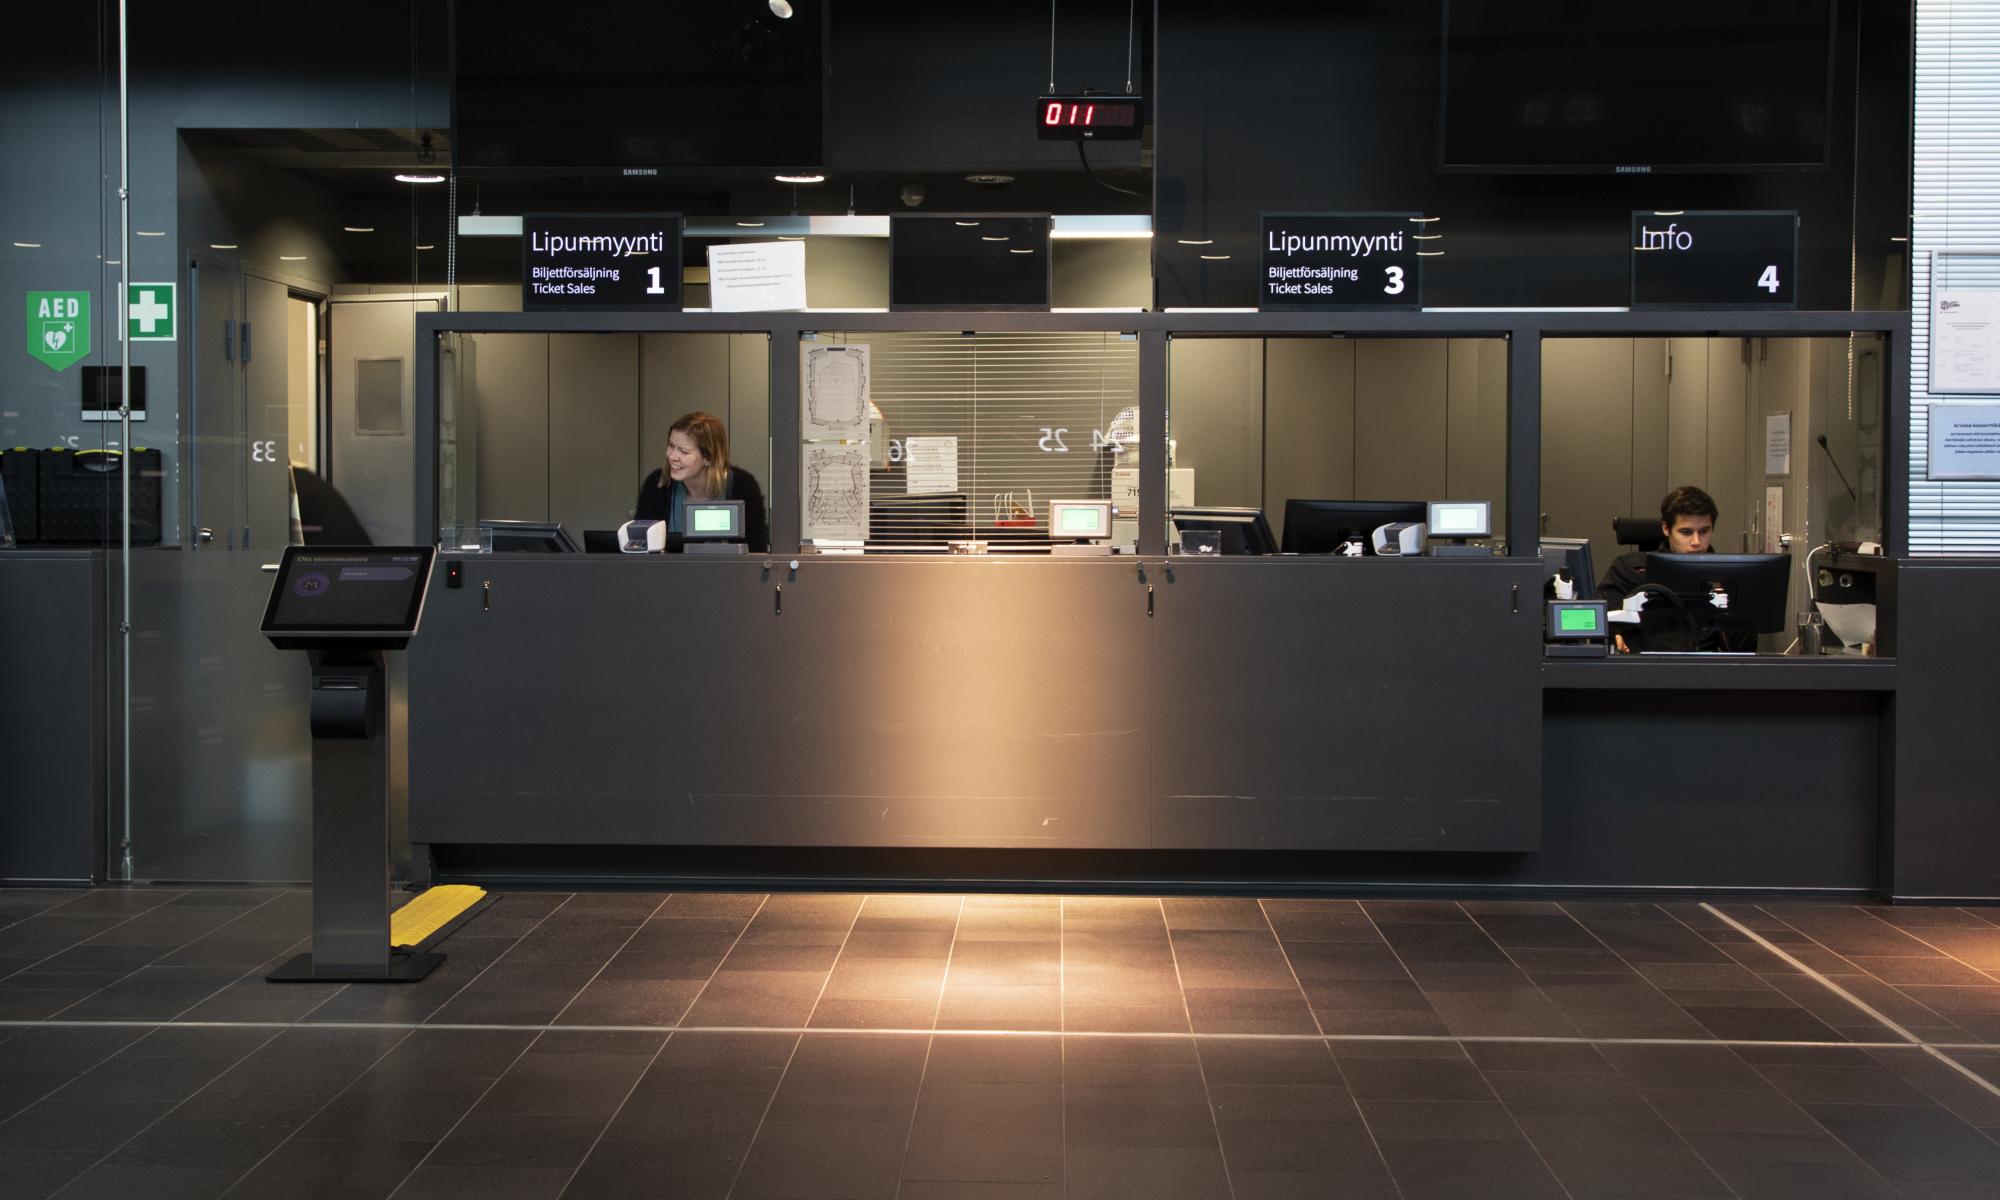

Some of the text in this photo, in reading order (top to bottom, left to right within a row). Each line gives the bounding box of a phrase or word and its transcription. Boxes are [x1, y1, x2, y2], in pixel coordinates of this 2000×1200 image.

[1045, 103, 1094, 125] 011
[623, 168, 658, 176] SAMSUNG
[532, 231, 664, 257] Lipunmyynti
[1268, 231, 1403, 257] Lipunmyynti
[1641, 223, 1693, 251] Info
[532, 266, 620, 281] Biljettförsäljning
[646, 266, 665, 294] 1
[1268, 266, 1358, 281] Biljettförsäljning
[1383, 266, 1405, 295] 3
[1757, 265, 1780, 293] 4
[532, 283, 596, 294] Ticket Sales
[1268, 283, 1333, 294] Ticket Sales
[38, 297, 80, 318] AED
